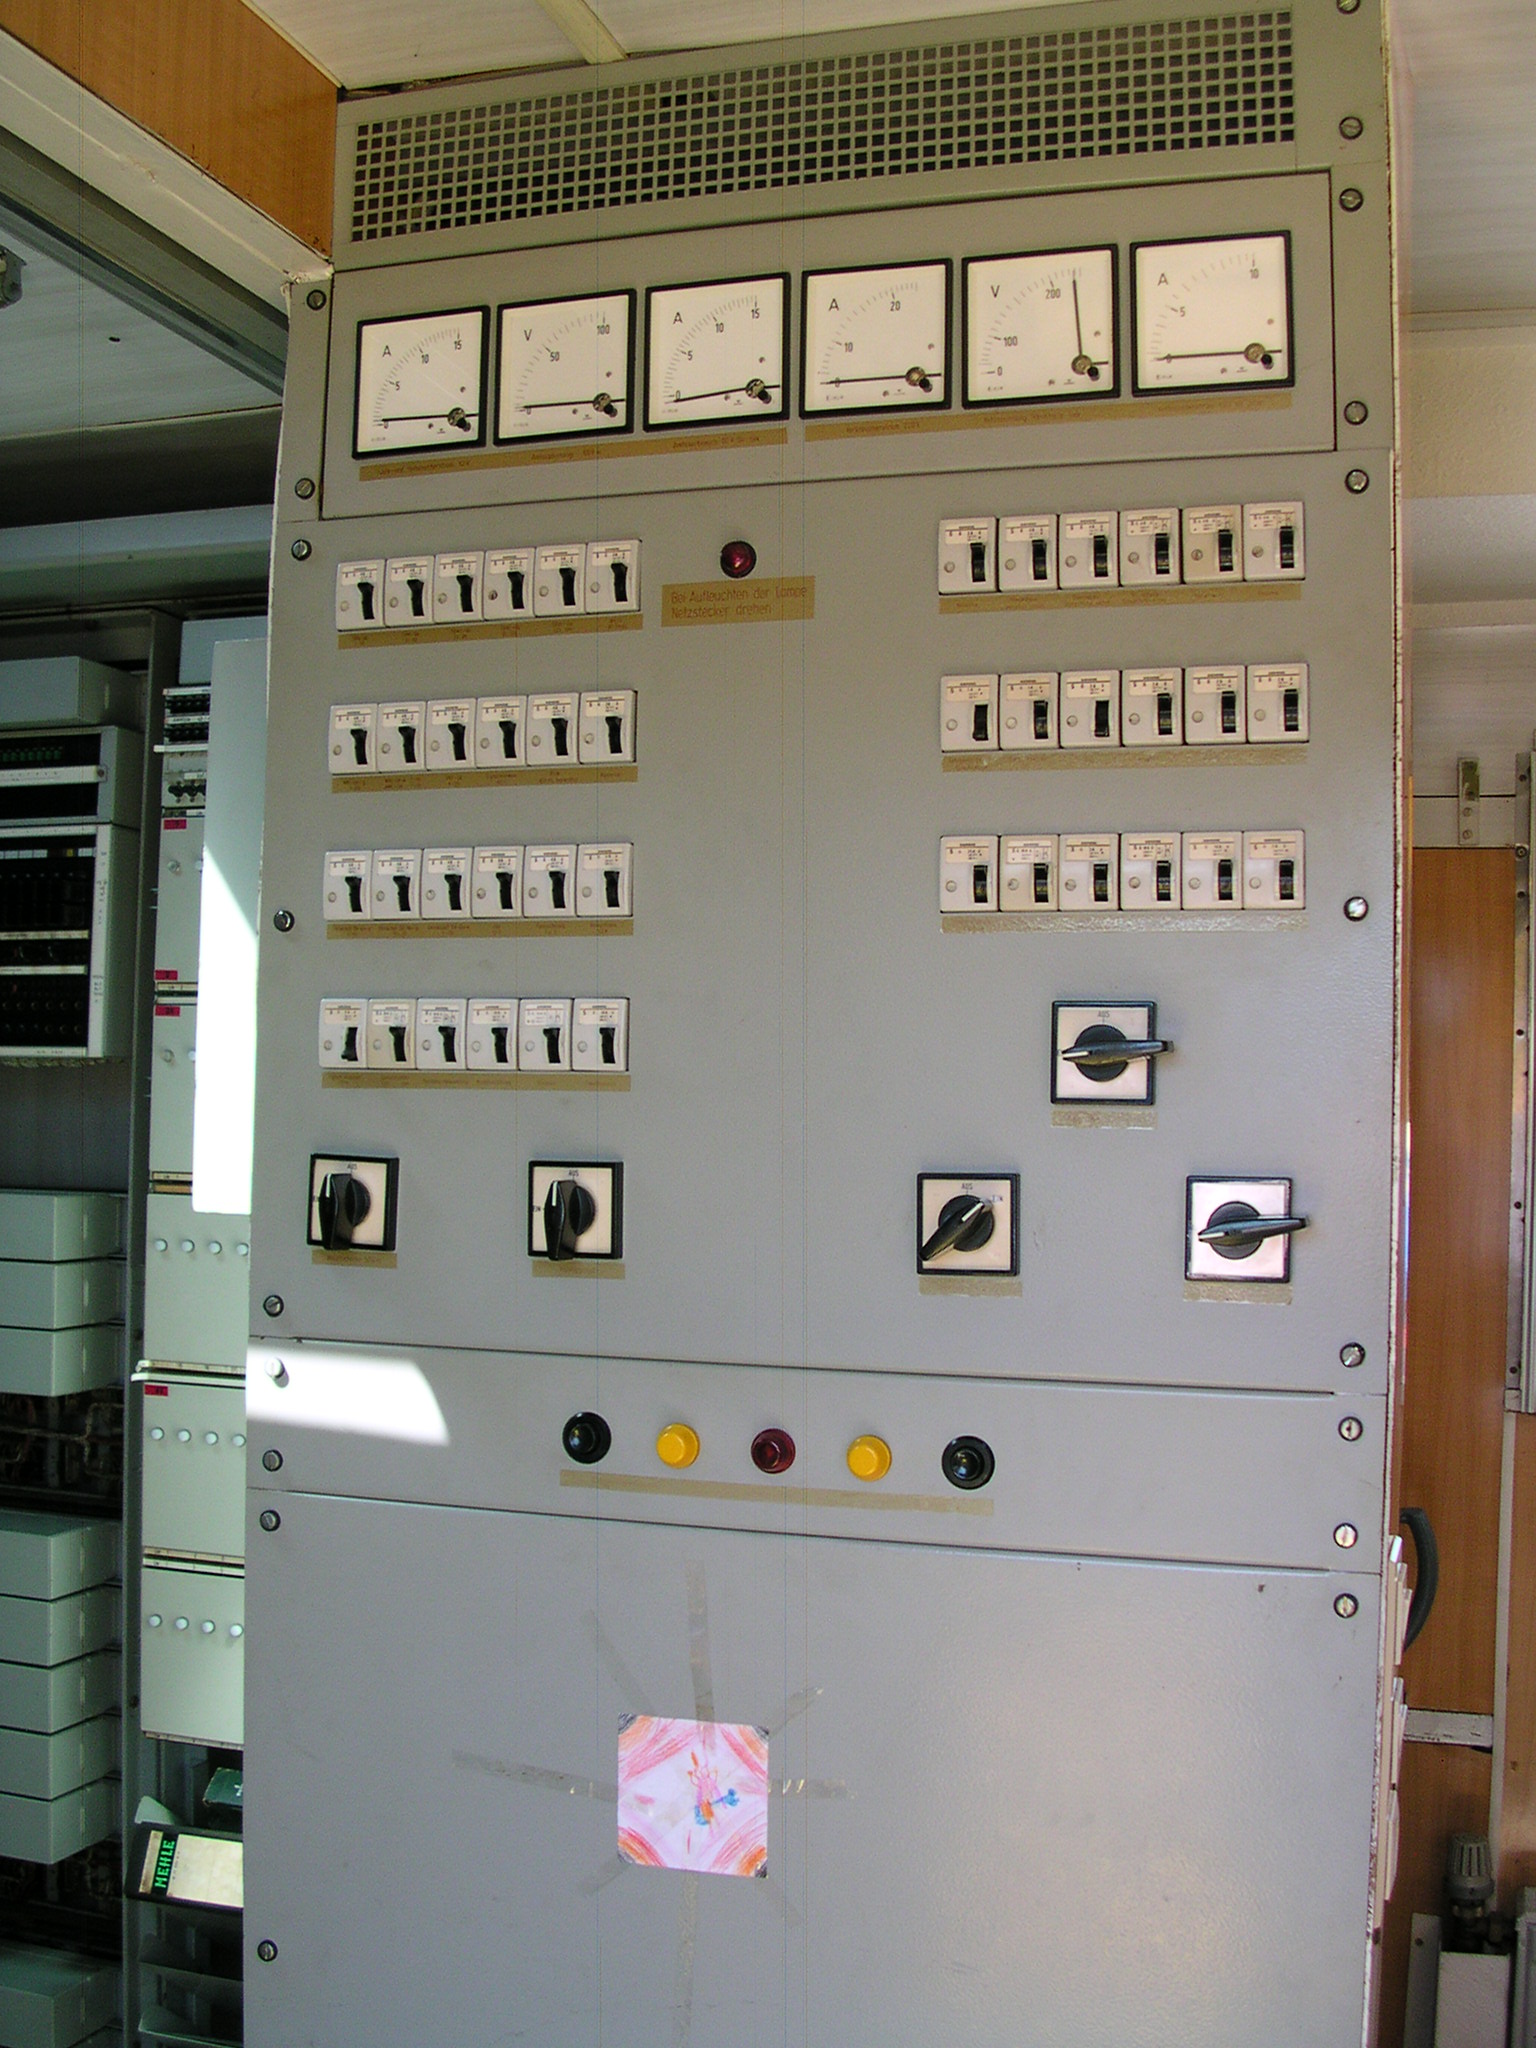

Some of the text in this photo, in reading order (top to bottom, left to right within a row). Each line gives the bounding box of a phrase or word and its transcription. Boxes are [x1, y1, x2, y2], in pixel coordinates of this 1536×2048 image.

[1157, 272, 1168, 286] A
[1250, 268, 1259, 279] 10
[991, 285, 1000, 298] V
[1045, 288, 1061, 299] 200
[829, 298, 839, 311] A
[890, 300, 901, 311] 20
[751, 308, 760, 319] 15
[1180, 306, 1186, 317] 5
[673, 311, 683, 324] A
[597, 324, 610, 335] 100
[715, 322, 724, 333] 10
[524, 329, 532, 341] V
[454, 340, 462, 350] 15
[1003, 336, 1018, 346] 100
[382, 345, 392, 357] A
[844, 342, 853, 352] 10
[421, 353, 430, 364] 10
[550, 351, 560, 361] 50
[687, 350, 693, 360] 5
[997, 366, 1003, 376] 0
[395, 381, 400, 391] 5
[752, 587, 770, 599] der
[671, 603, 772, 619] Netzstecker drehen
